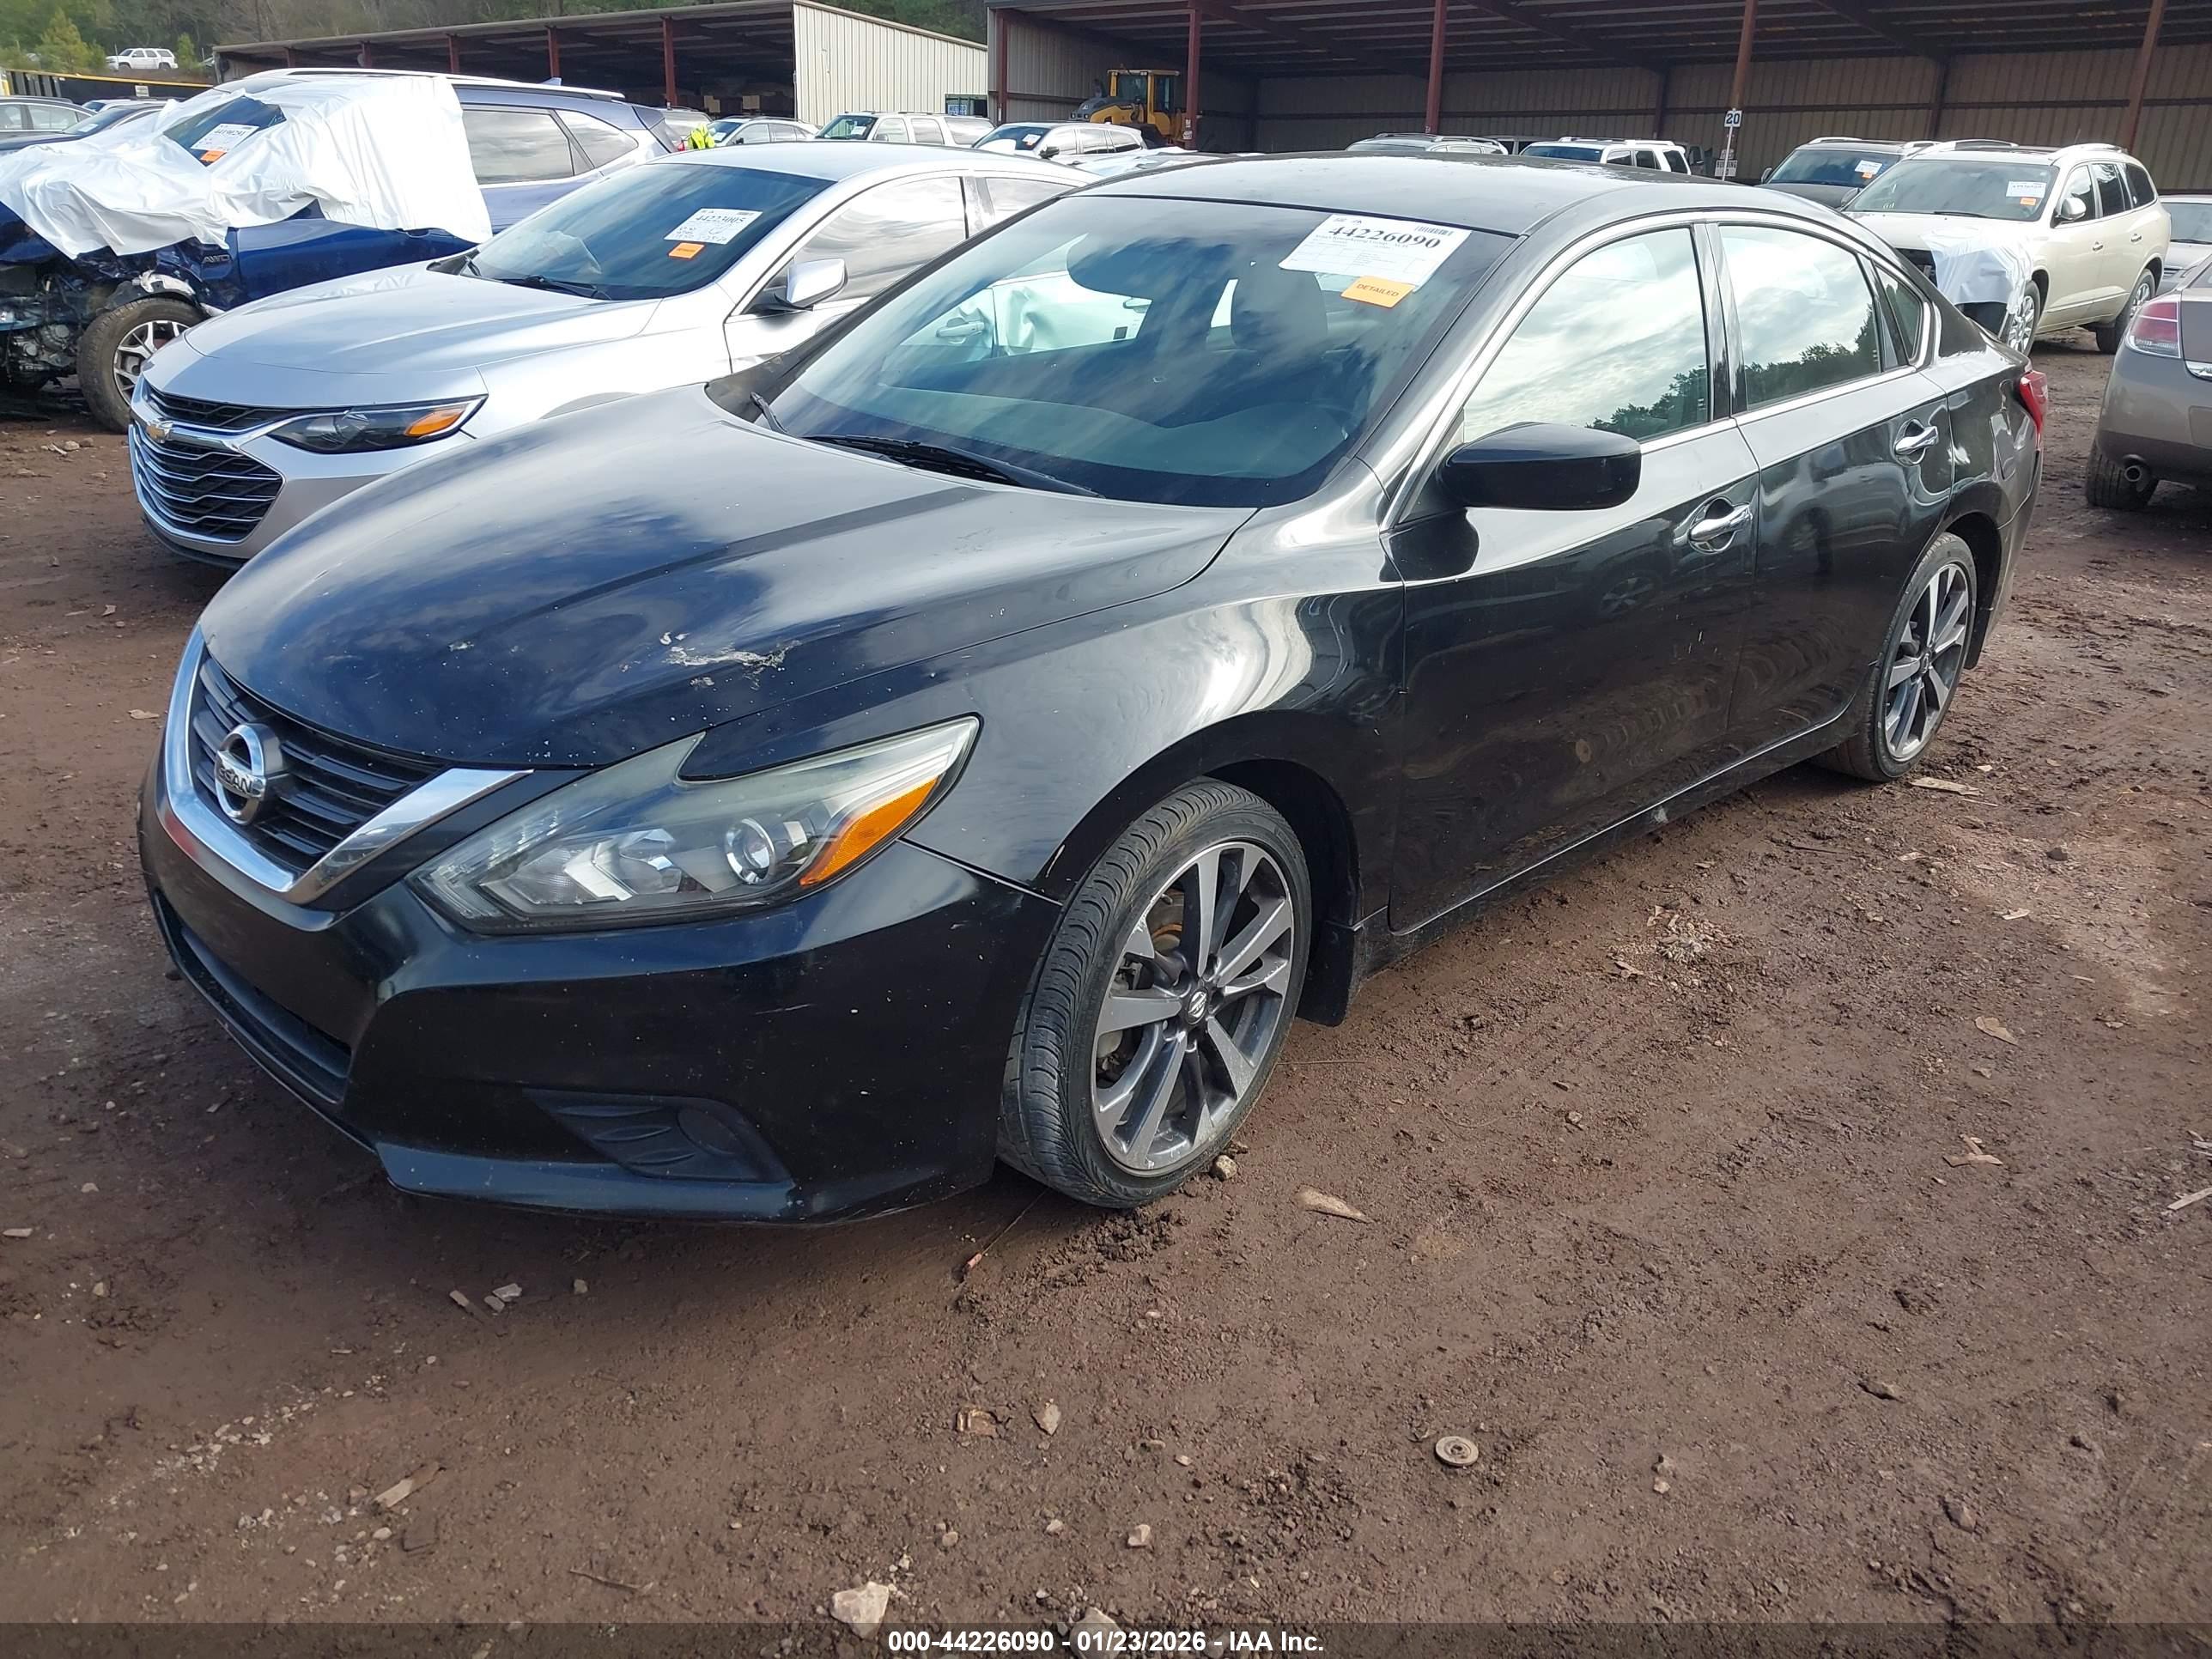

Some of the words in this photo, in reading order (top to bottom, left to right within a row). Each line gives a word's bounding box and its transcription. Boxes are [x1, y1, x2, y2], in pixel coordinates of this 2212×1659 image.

[1726, 113, 1741, 125] 20
[1328, 226, 1441, 248] 44226090
[202, 254, 230, 264] AWD
[1356, 283, 1400, 297] DETAILED
